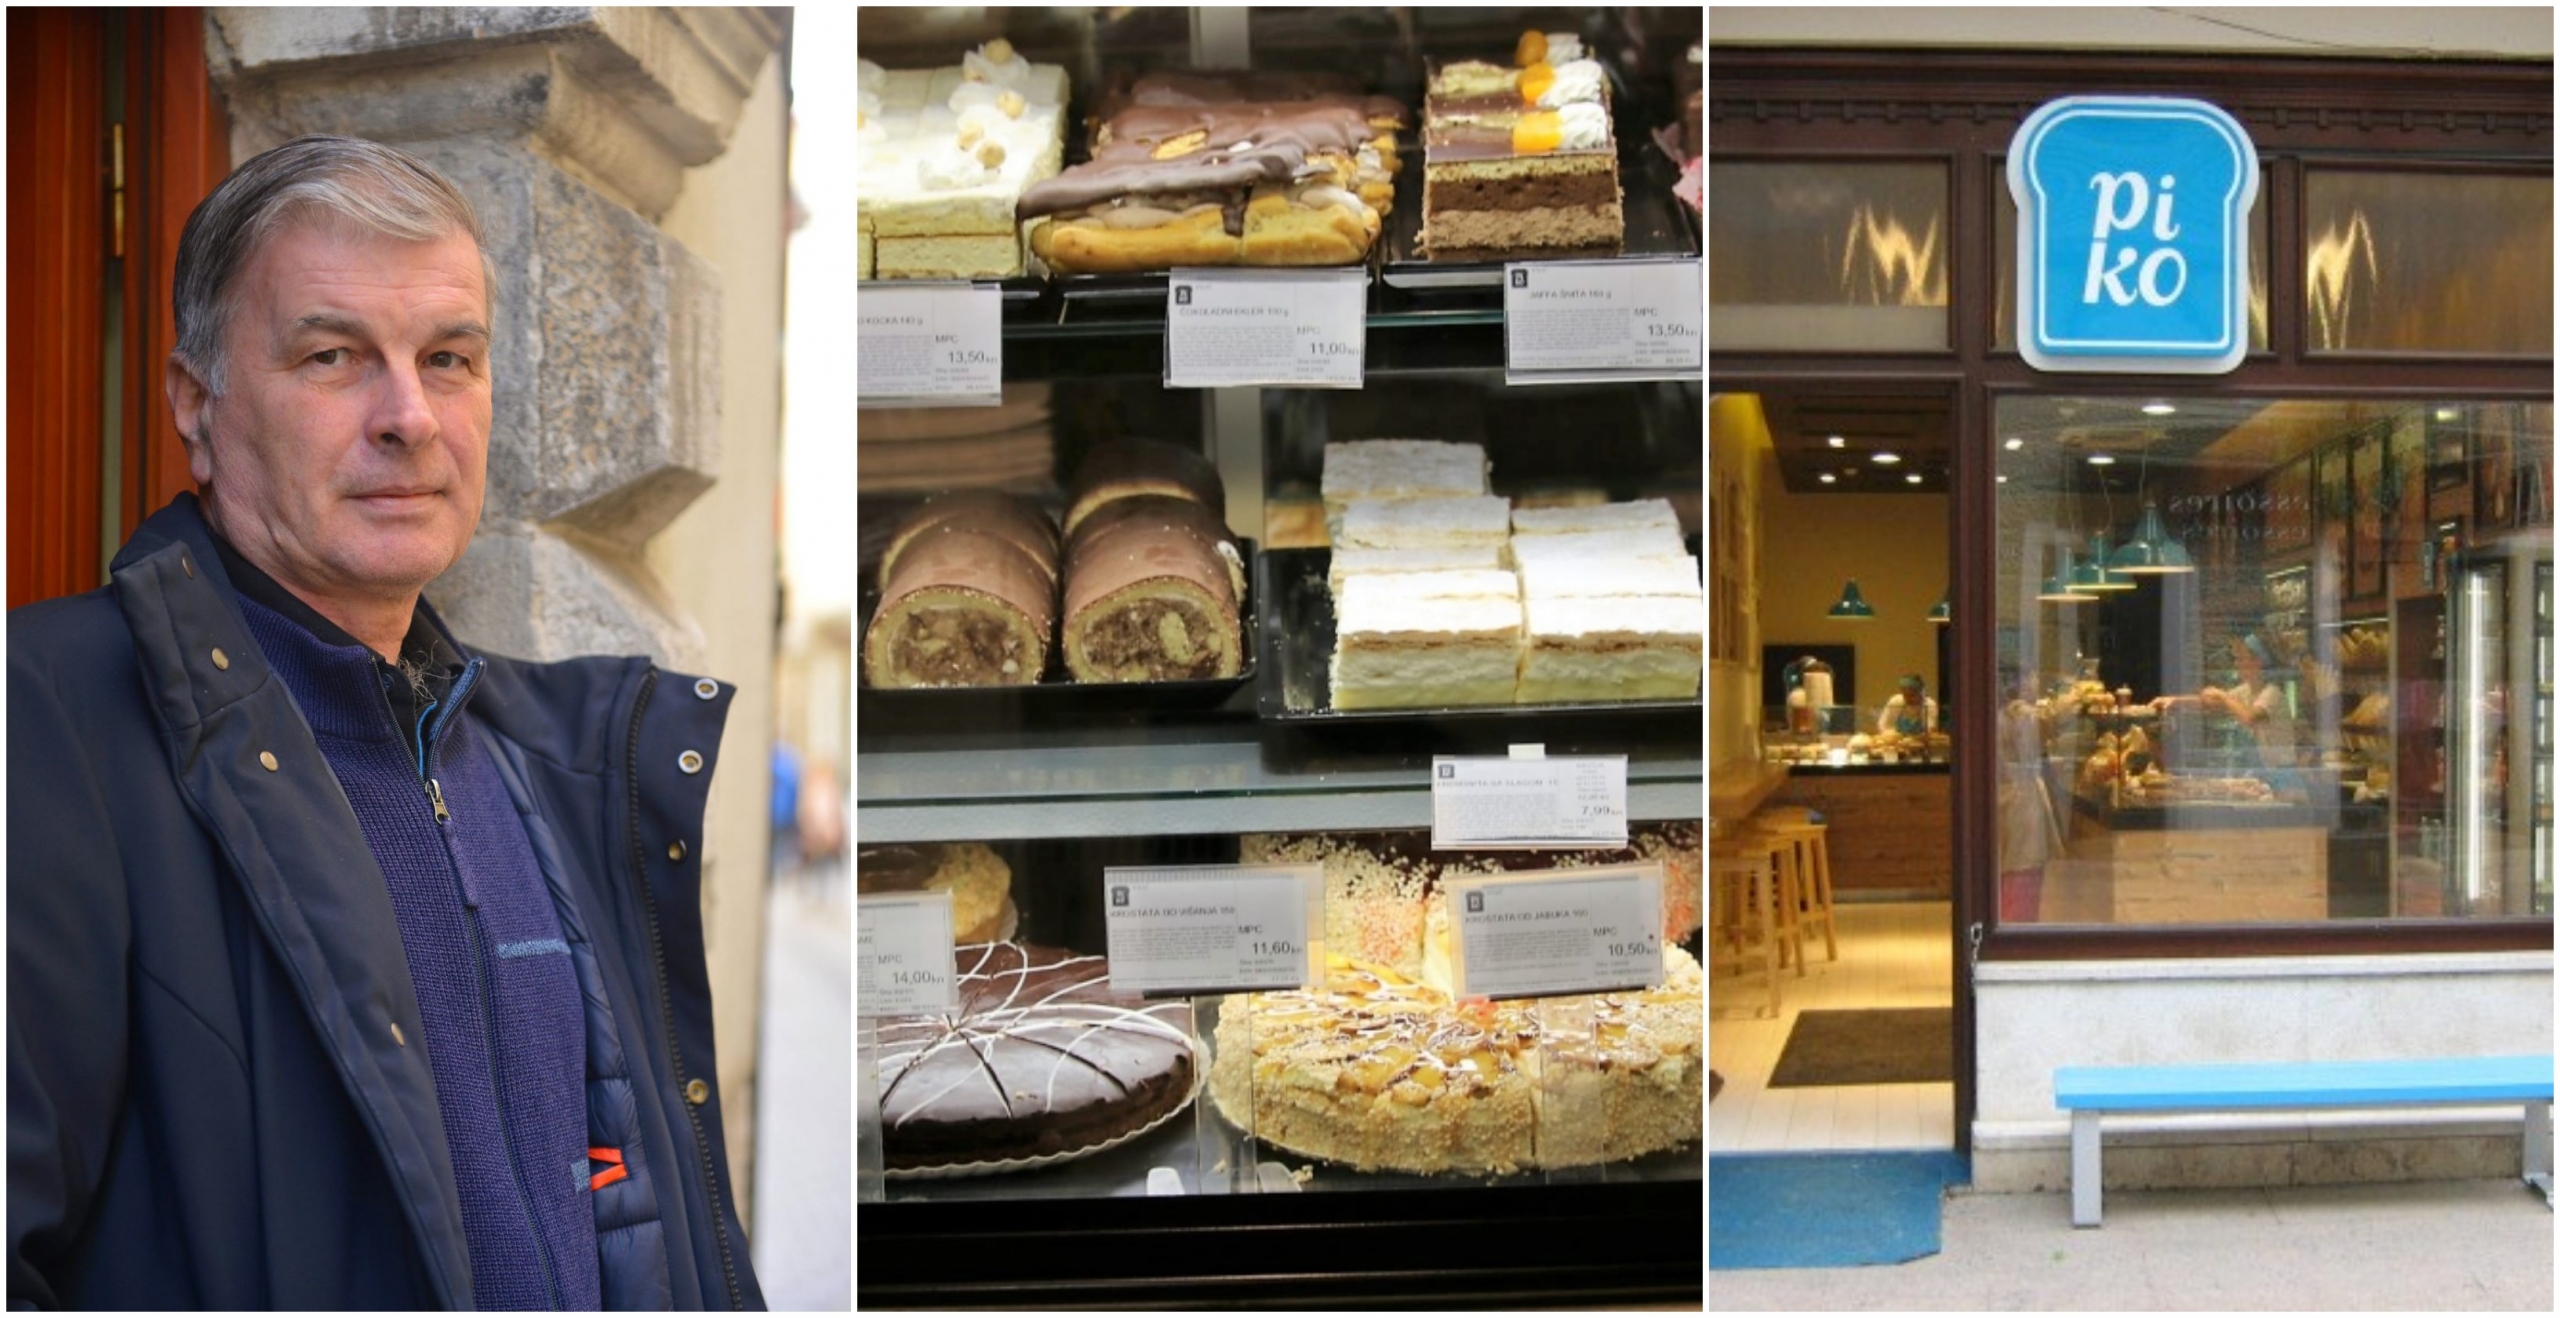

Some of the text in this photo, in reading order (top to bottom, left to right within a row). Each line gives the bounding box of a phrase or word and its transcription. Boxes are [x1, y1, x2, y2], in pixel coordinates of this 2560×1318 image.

[2088, 171, 2181, 241] pi
[2082, 242, 2188, 307] ko
[1634, 307, 1658, 317] MPC
[1296, 325, 1321, 335] MPC
[934, 333, 958, 344] MPC
[1238, 925, 1263, 935] MPC
[1593, 927, 1618, 938] MPC
[878, 954, 902, 965] MPC
